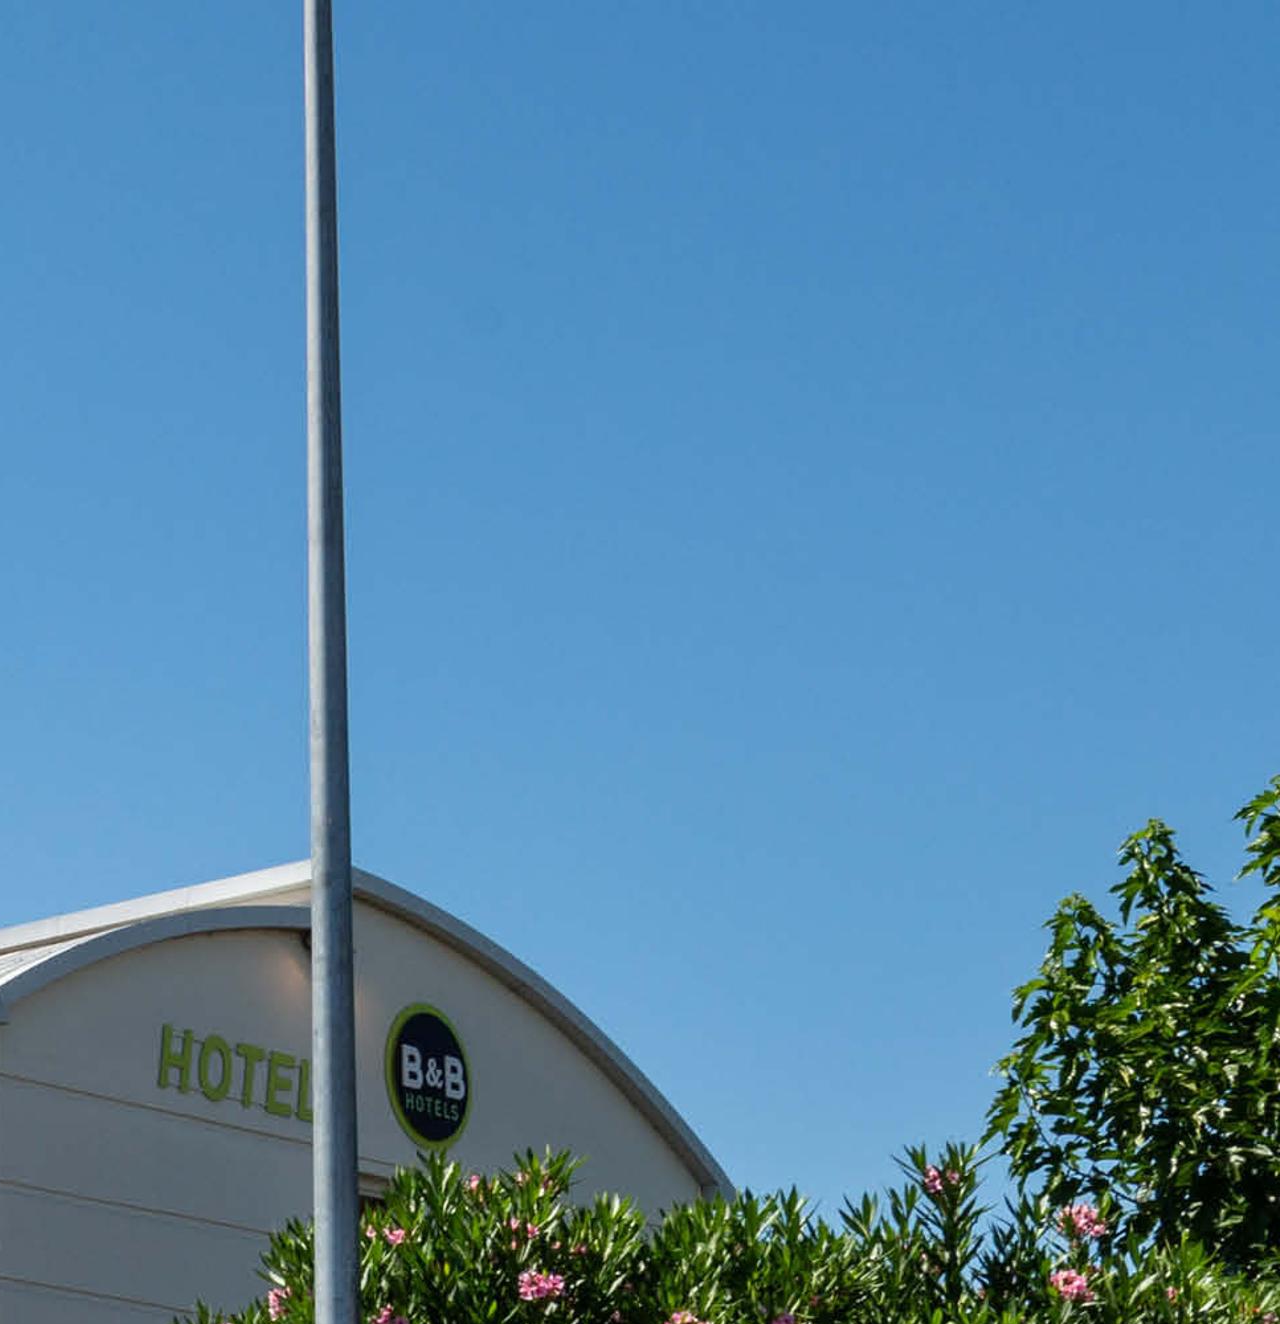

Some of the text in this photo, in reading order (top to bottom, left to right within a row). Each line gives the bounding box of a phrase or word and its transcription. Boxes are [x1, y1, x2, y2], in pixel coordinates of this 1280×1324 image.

[157, 1023, 313, 1123] HOTEL
[401, 1044, 466, 1101] B&B
[405, 1091, 460, 1122] HOTELS
